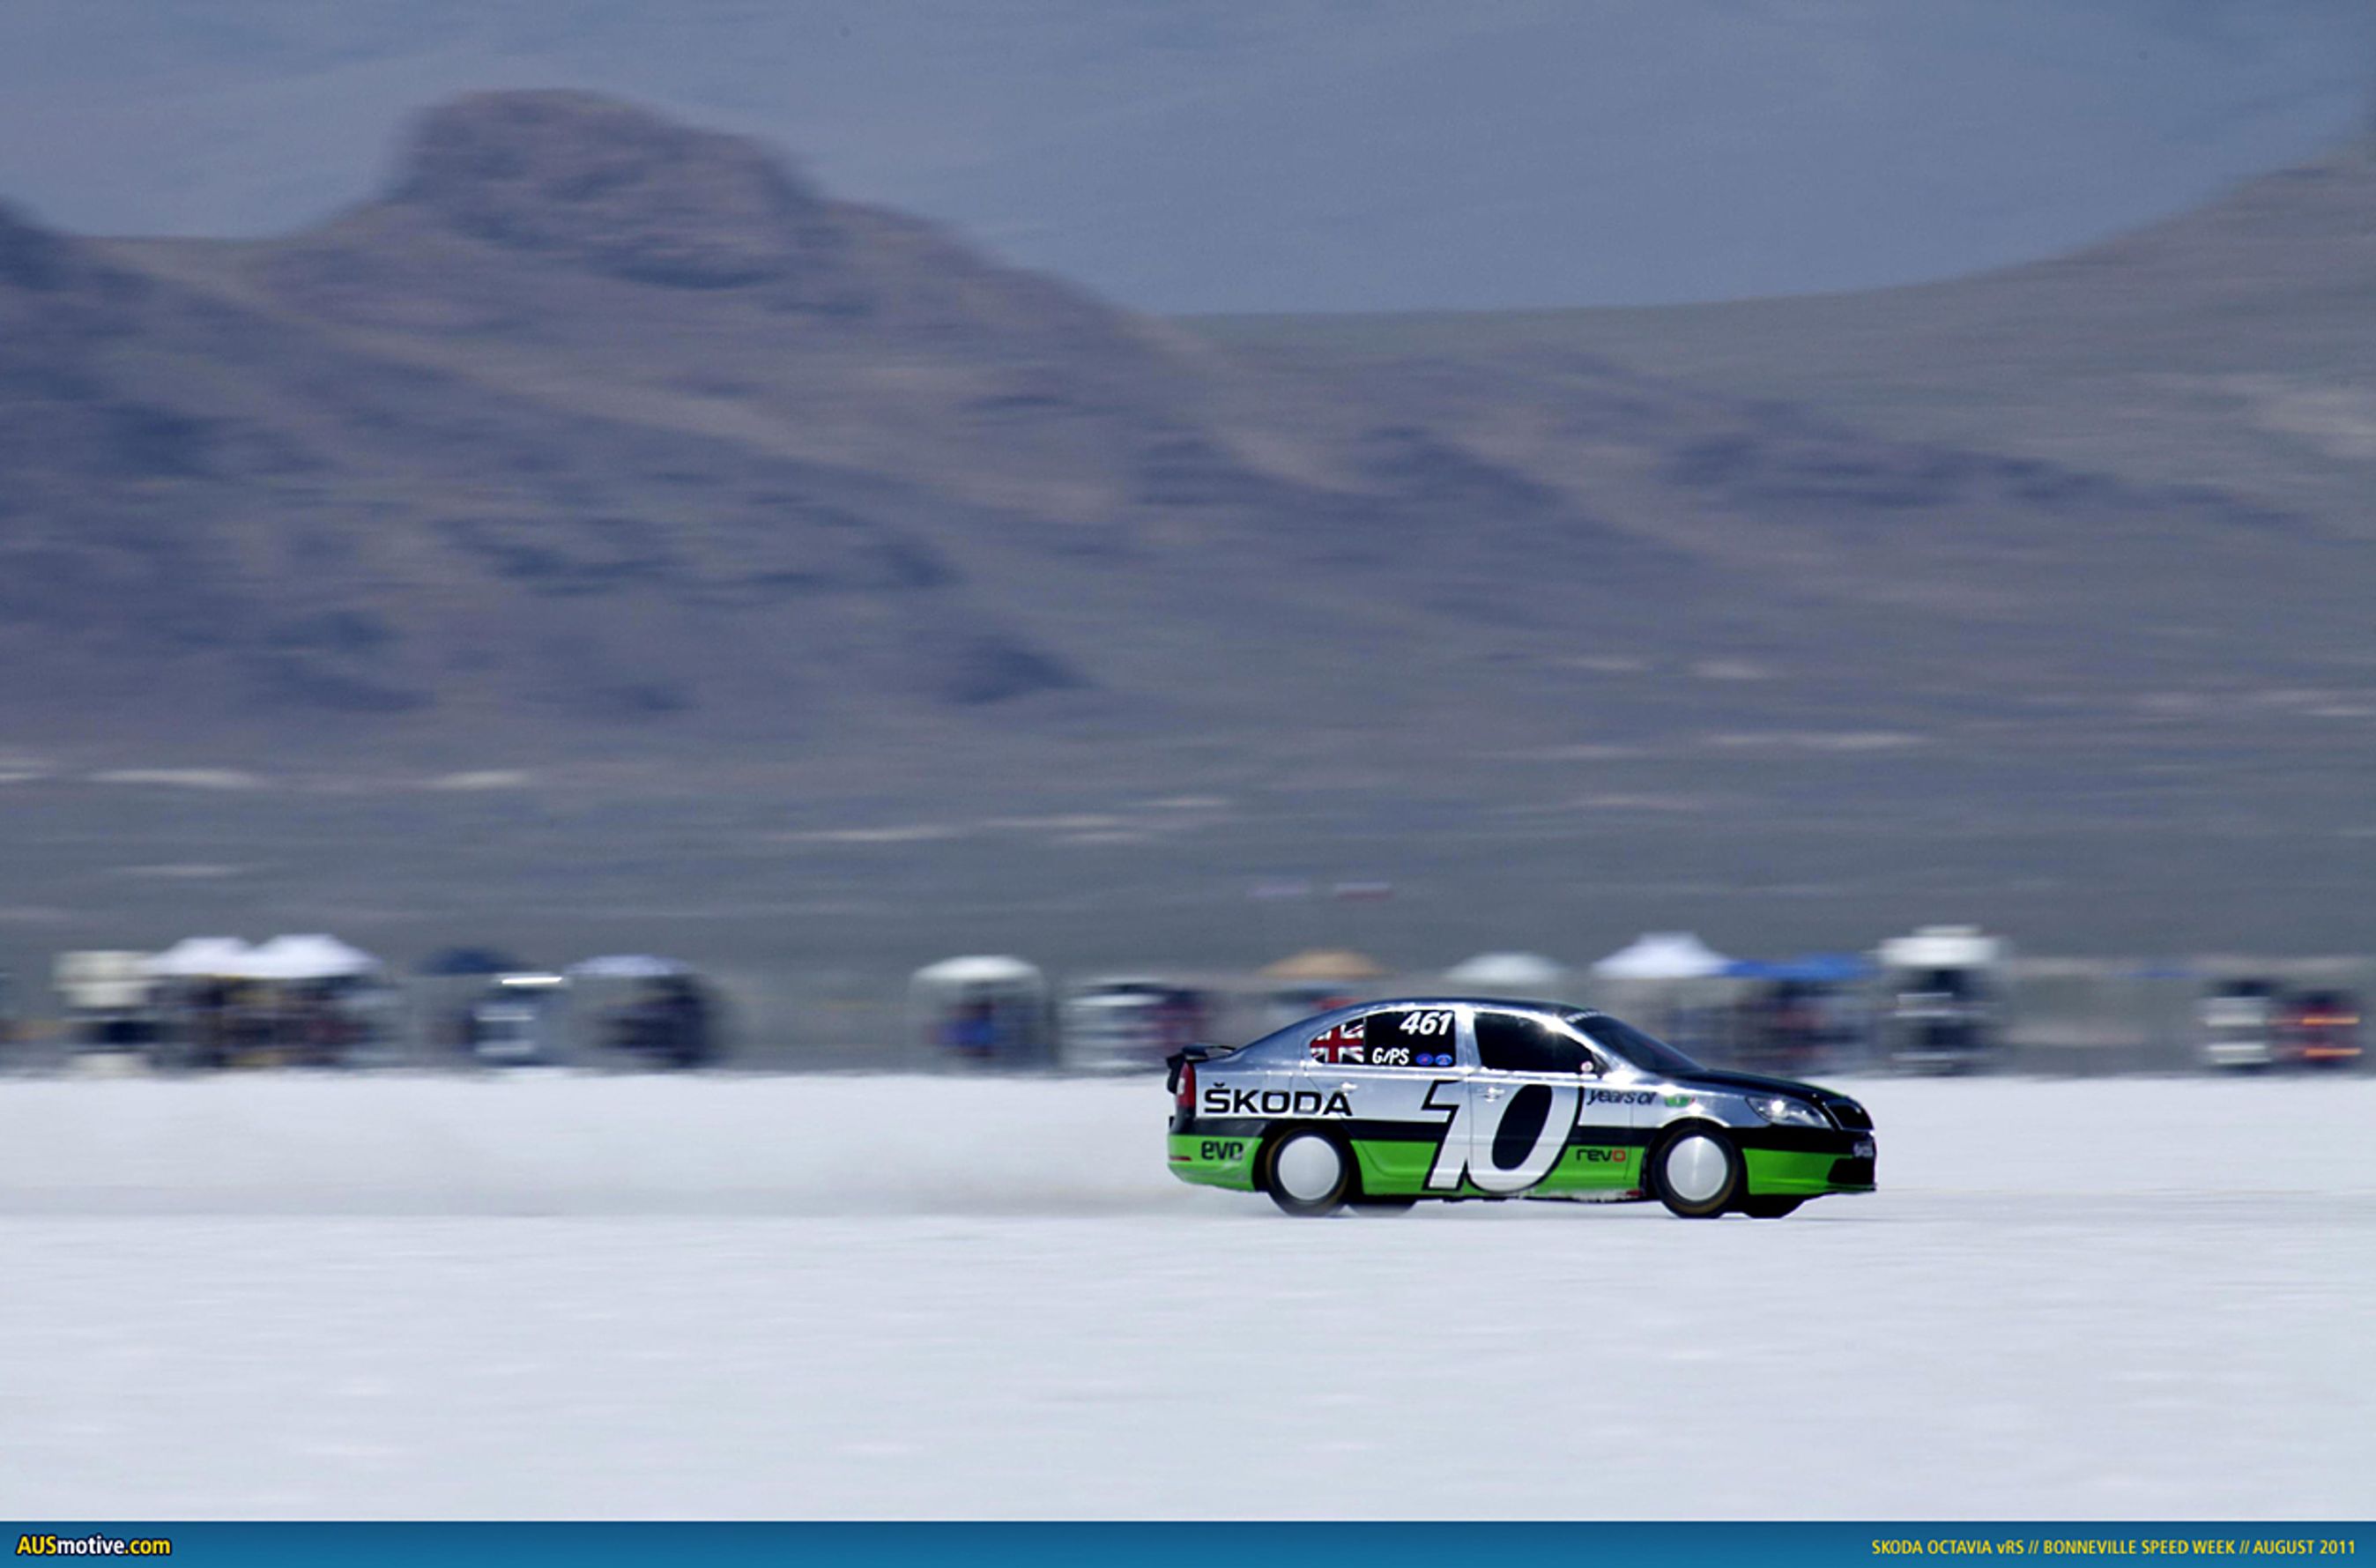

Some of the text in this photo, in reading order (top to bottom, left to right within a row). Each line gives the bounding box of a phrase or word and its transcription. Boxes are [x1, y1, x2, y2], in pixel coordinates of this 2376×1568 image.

[1399, 1011, 1453, 1036] 461
[1371, 1046, 1410, 1066] G/PS
[1204, 1082, 1353, 1117] ŠKODA
[1585, 1088, 1635, 1106] years
[1200, 1140, 1244, 1161] evo
[1576, 1148, 1627, 1163] revo
